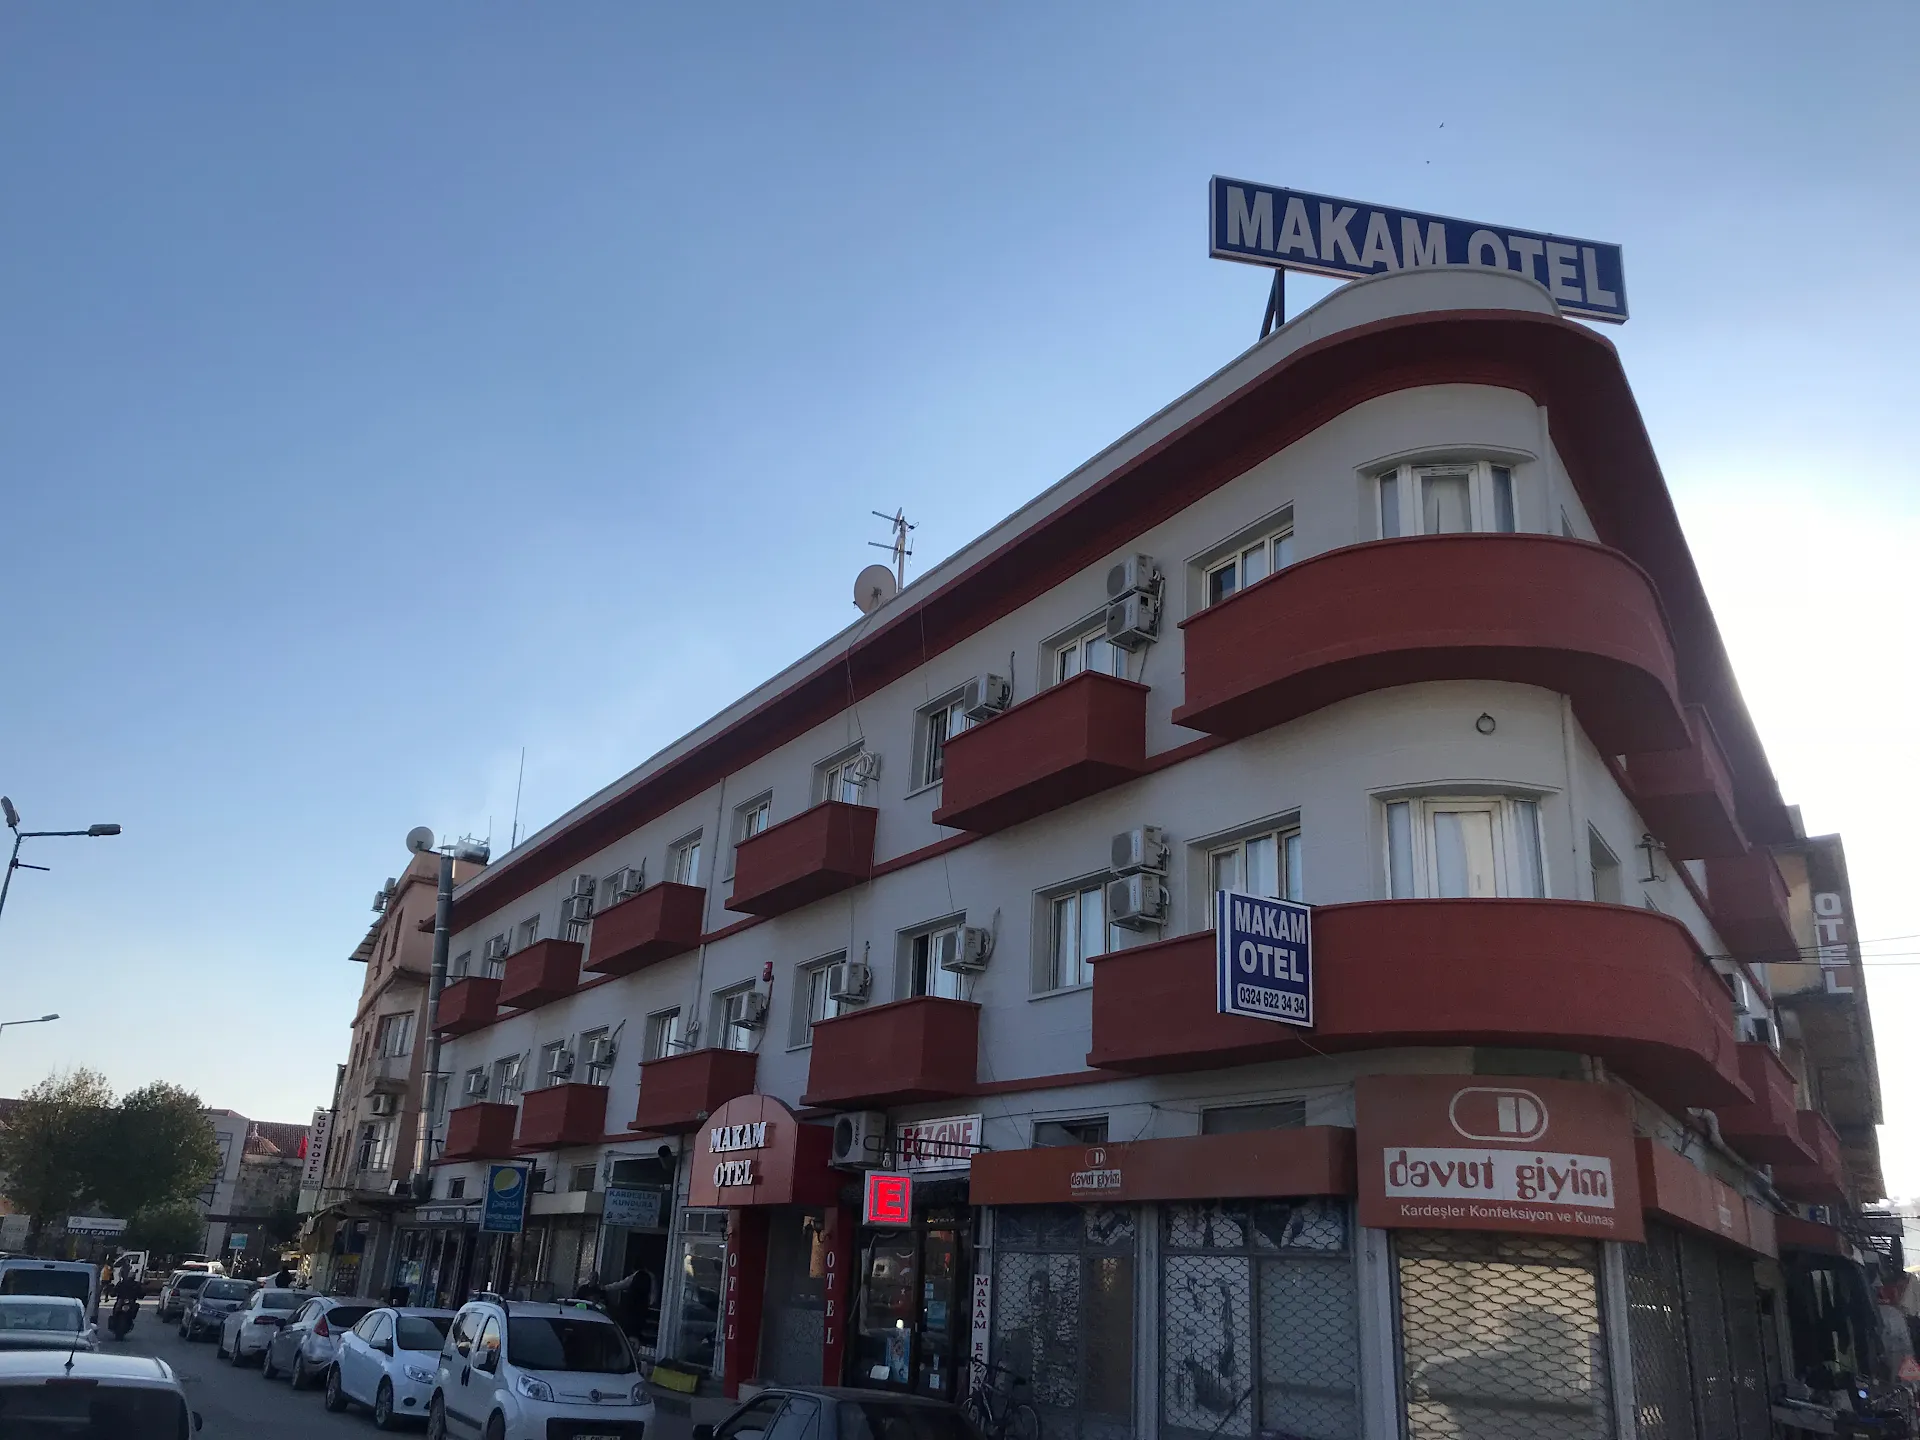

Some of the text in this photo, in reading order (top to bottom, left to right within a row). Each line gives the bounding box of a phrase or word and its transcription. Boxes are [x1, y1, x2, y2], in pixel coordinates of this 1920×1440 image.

[1225, 185, 1617, 308] MAKAM OTEL
[1235, 900, 1306, 945] MAKAM
[1238, 940, 1305, 983] OTEL
[1814, 892, 1854, 995] OTEL
[1240, 986, 1305, 1014] 0324 622 34 34
[708, 1121, 767, 1153] MAKAM
[903, 1121, 973, 1163] ECZANE
[308, 1153, 320, 1179] OTEL
[713, 1159, 754, 1188] OTEL
[1097, 1171, 1120, 1188] giyim
[1388, 1149, 1608, 1201] davut giyim
[491, 1200, 519, 1210] pepsi
[612, 1198, 653, 1208] KUNDURA
[877, 1181, 902, 1216] E
[1400, 1203, 1615, 1229] Kardeşler Konfeksiyon ve Kumaş
[727, 1252, 738, 1340] OTEL
[825, 1250, 836, 1345] OTEL
[973, 1277, 989, 1330] MAKAM
